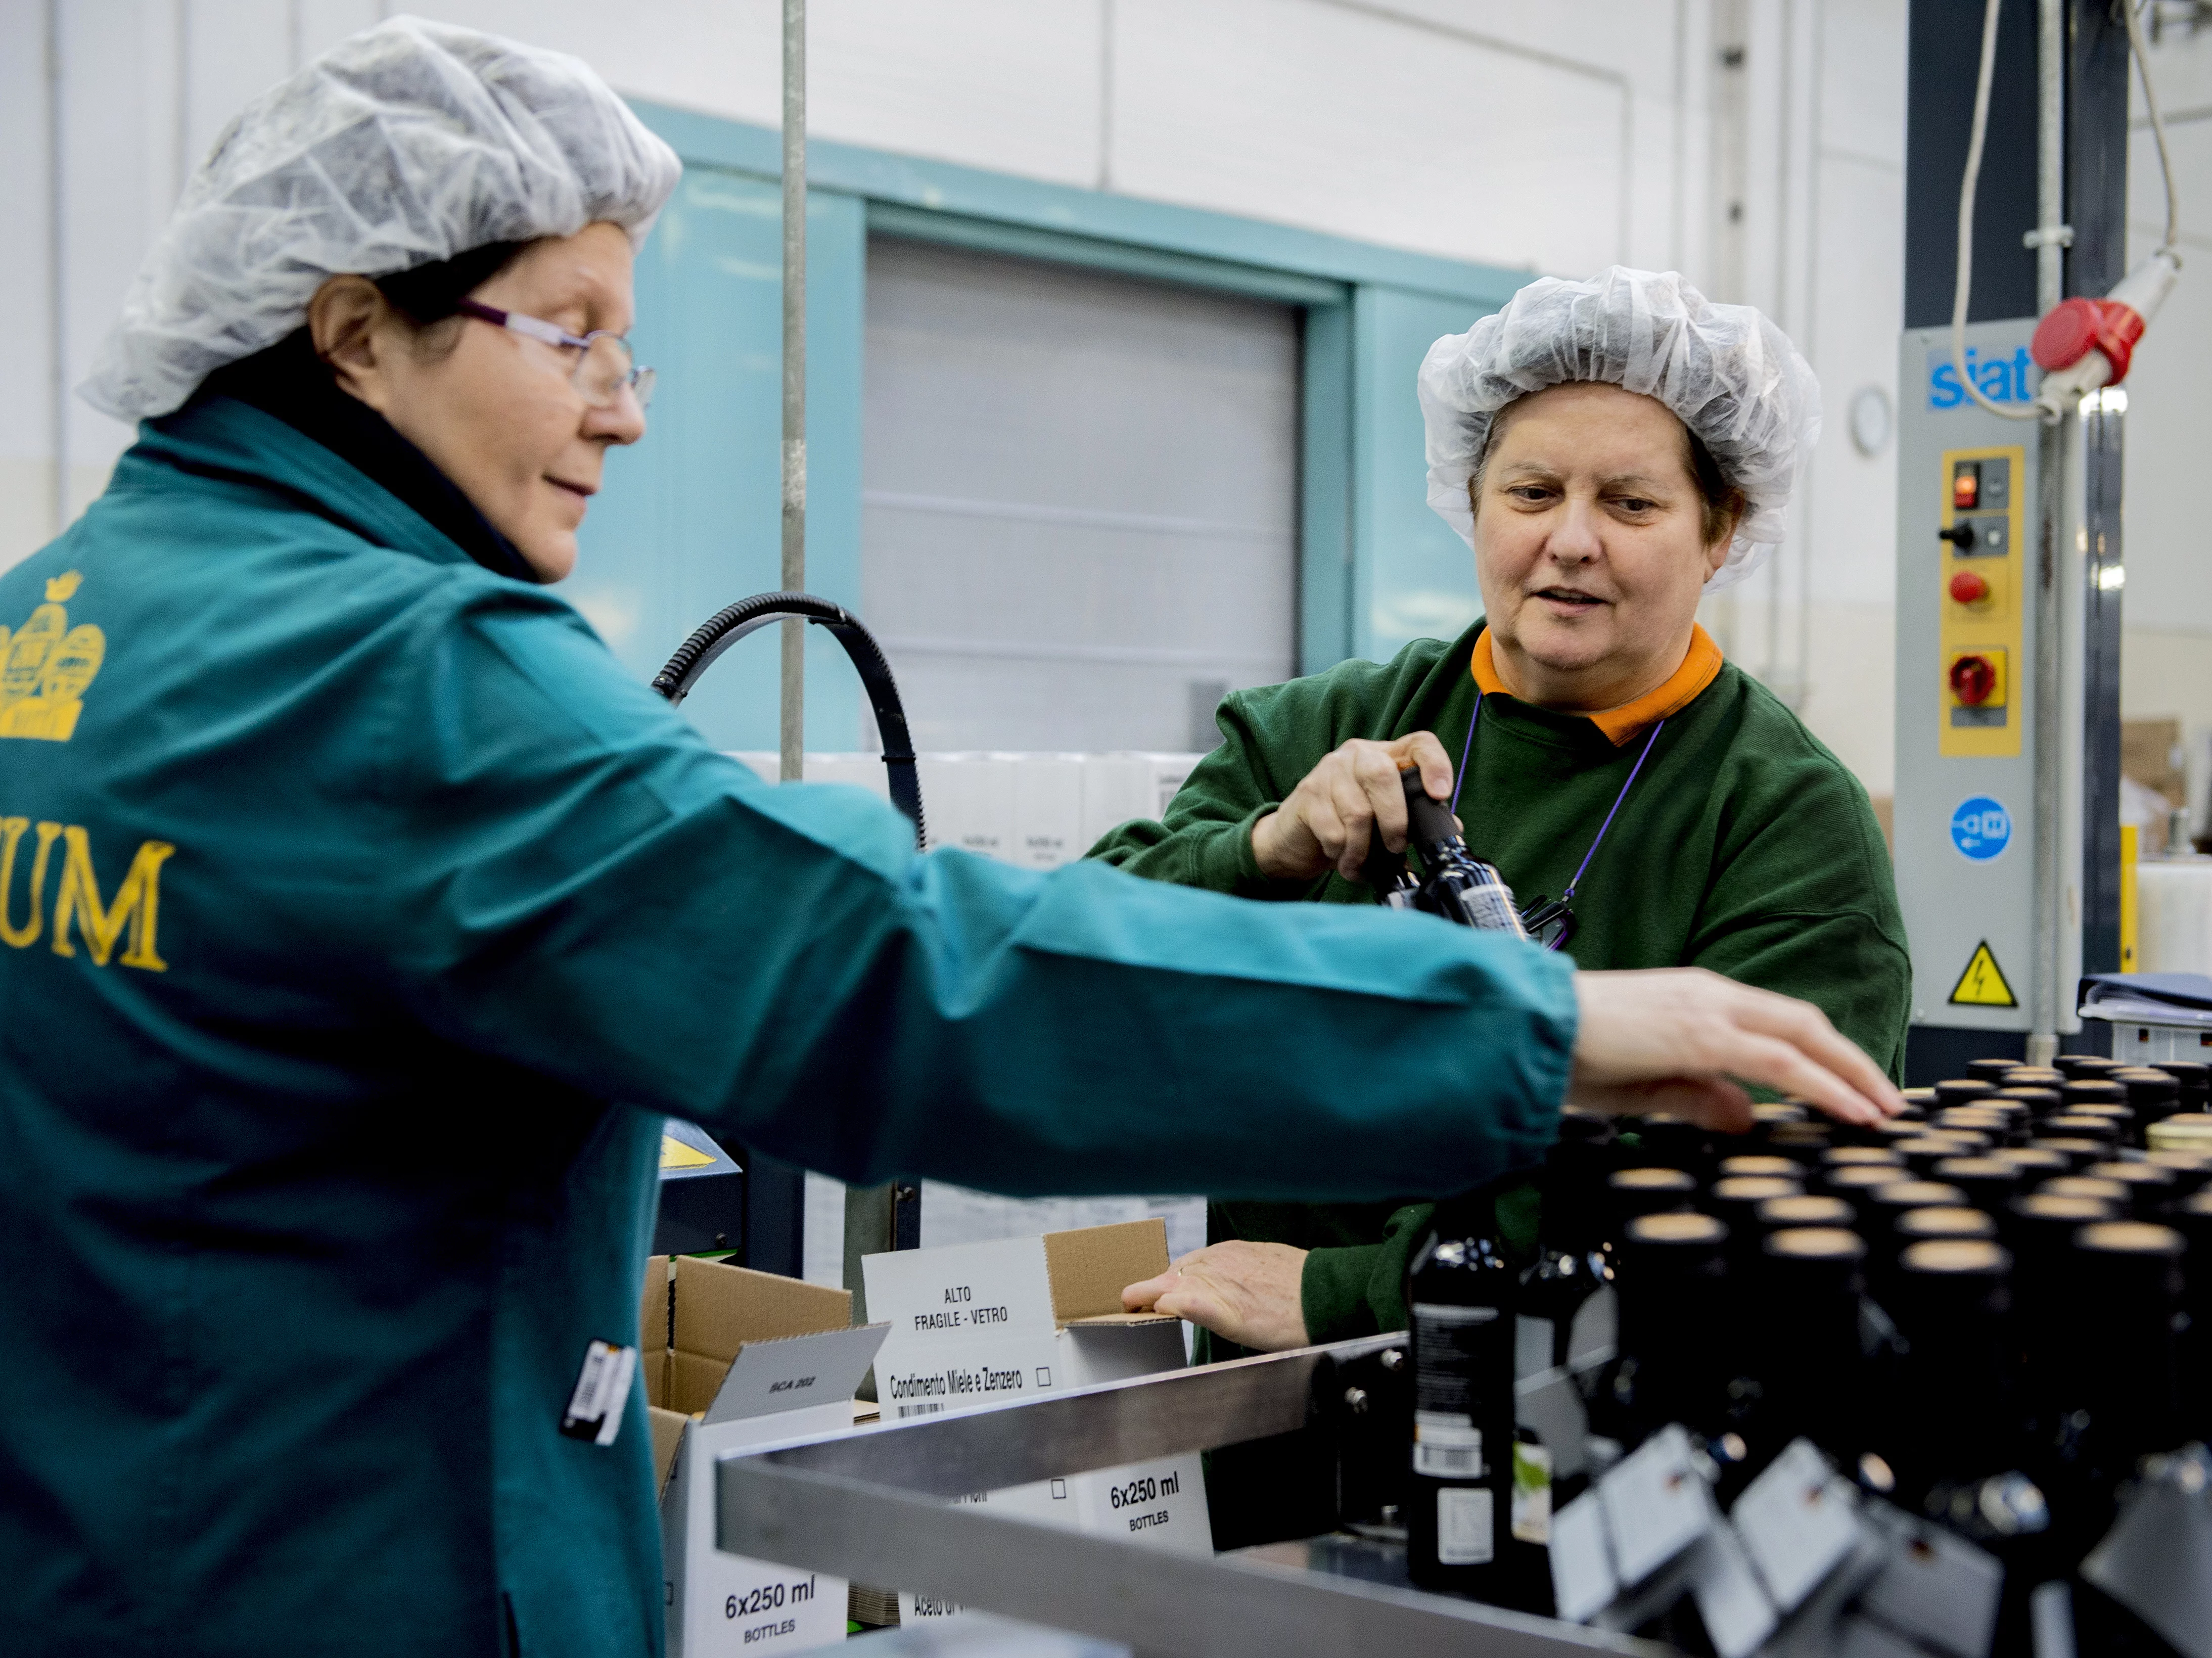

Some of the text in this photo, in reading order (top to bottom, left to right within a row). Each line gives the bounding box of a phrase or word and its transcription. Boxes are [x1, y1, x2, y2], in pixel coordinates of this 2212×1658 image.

[1931, 345, 2031, 408] siat
[945, 1286, 971, 1304] ALTO
[915, 1311, 960, 1330] FRAGILE
[971, 1306, 1007, 1324] VETRO
[890, 1367, 1022, 1399] Condimento Miele e Zenzero
[1111, 1470, 1180, 1509] 6x250 ml
[1130, 1510, 1169, 1532] BOTTLES
[726, 1574, 815, 1619] 6x250 ml
[744, 1619, 796, 1644] BOTTLES
